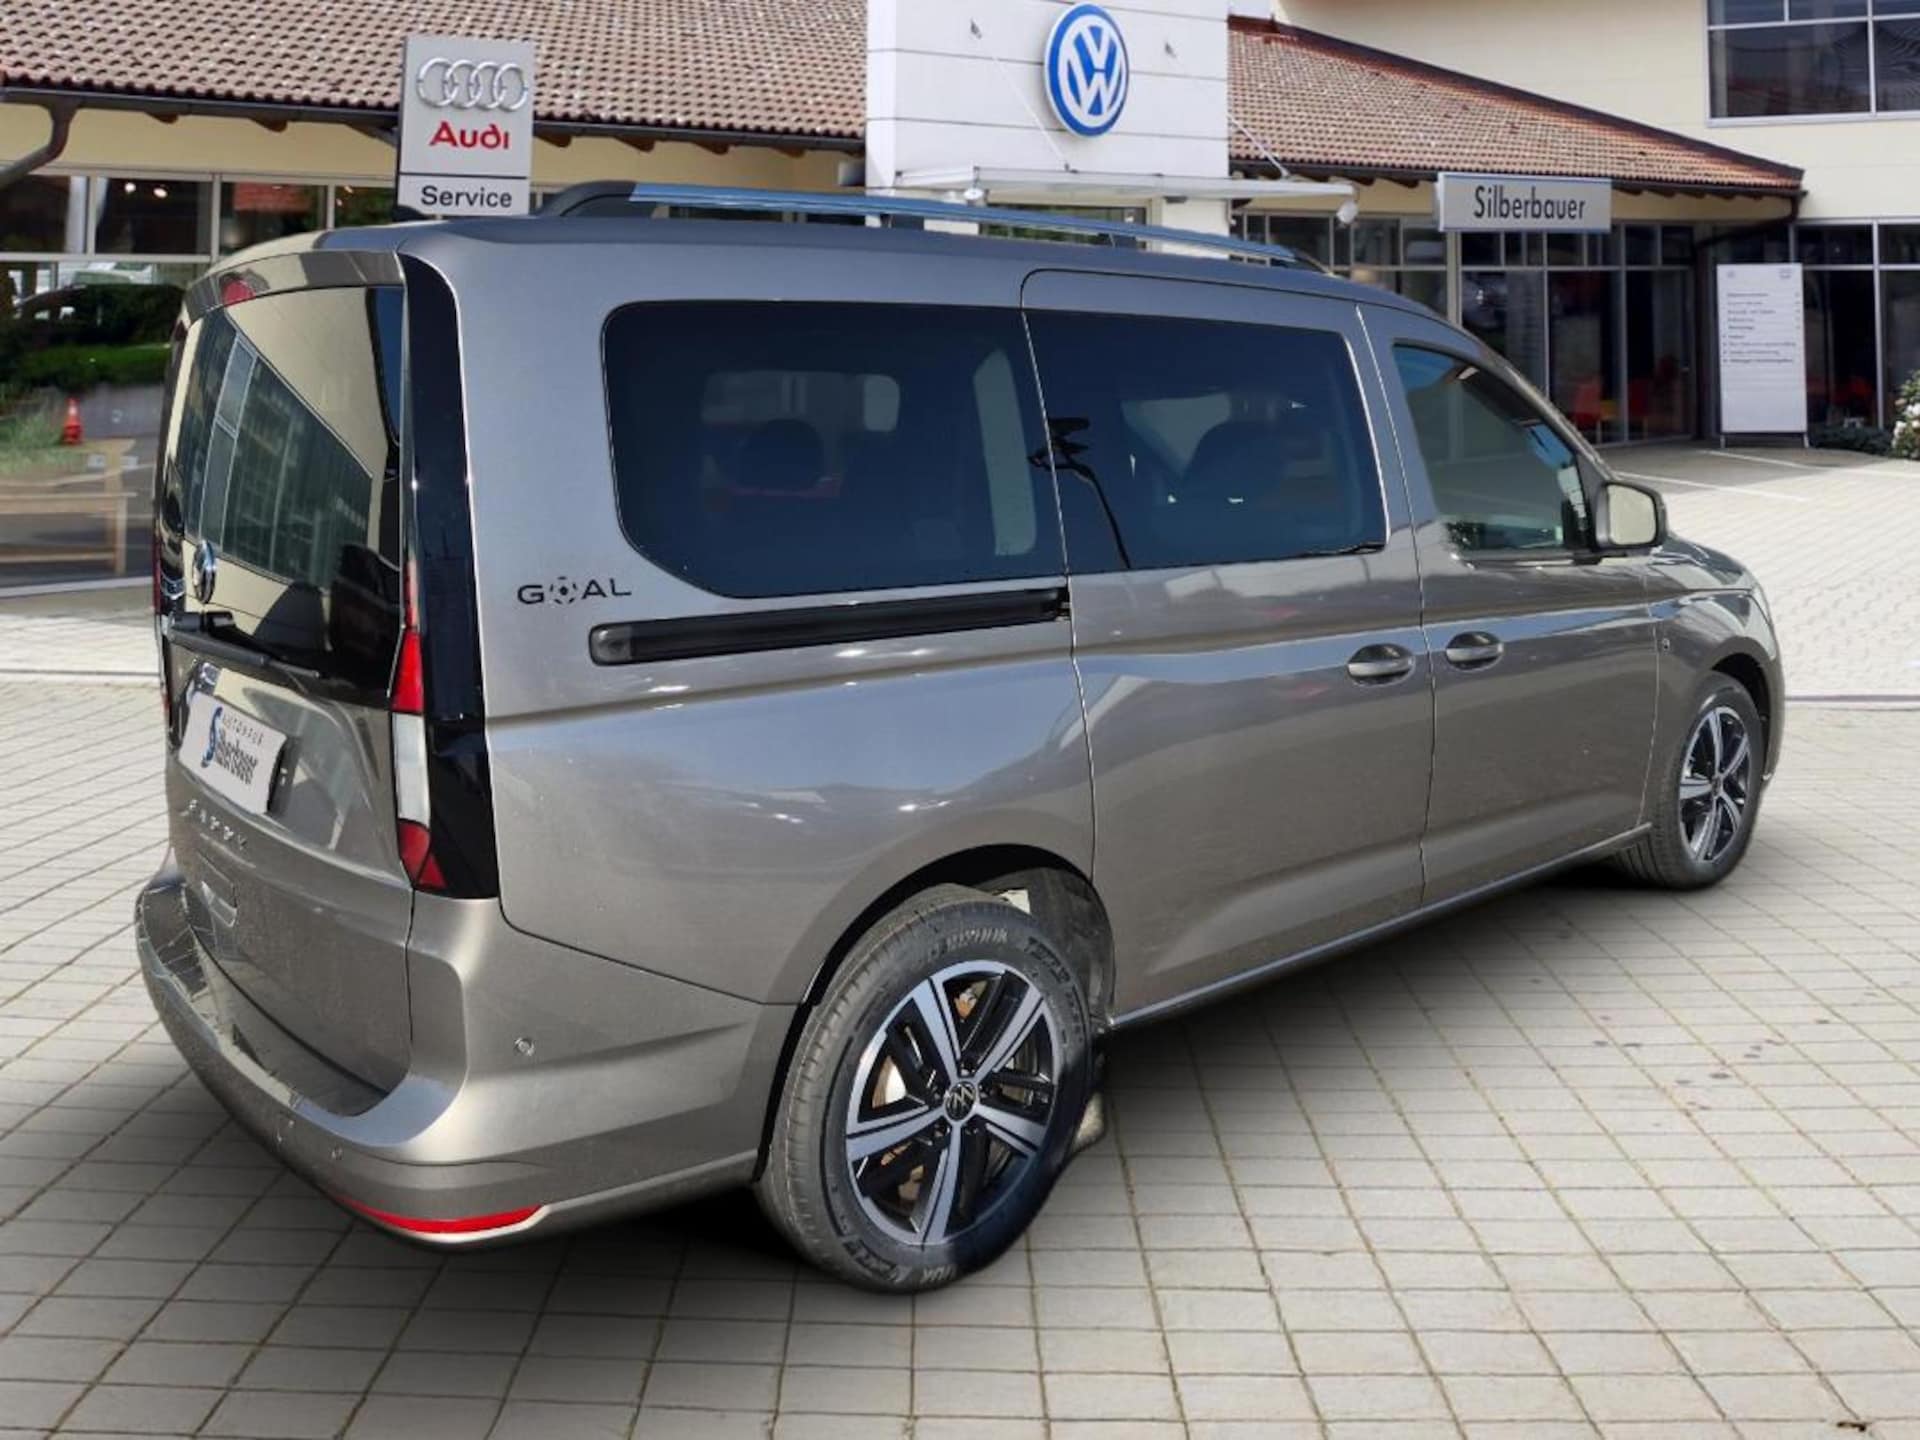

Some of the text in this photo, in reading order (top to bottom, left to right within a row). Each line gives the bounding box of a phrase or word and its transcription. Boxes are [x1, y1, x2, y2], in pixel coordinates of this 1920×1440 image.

[429, 120, 511, 150] Audi
[420, 185, 512, 208] Service
[1473, 184, 1586, 220] Silberbauer
